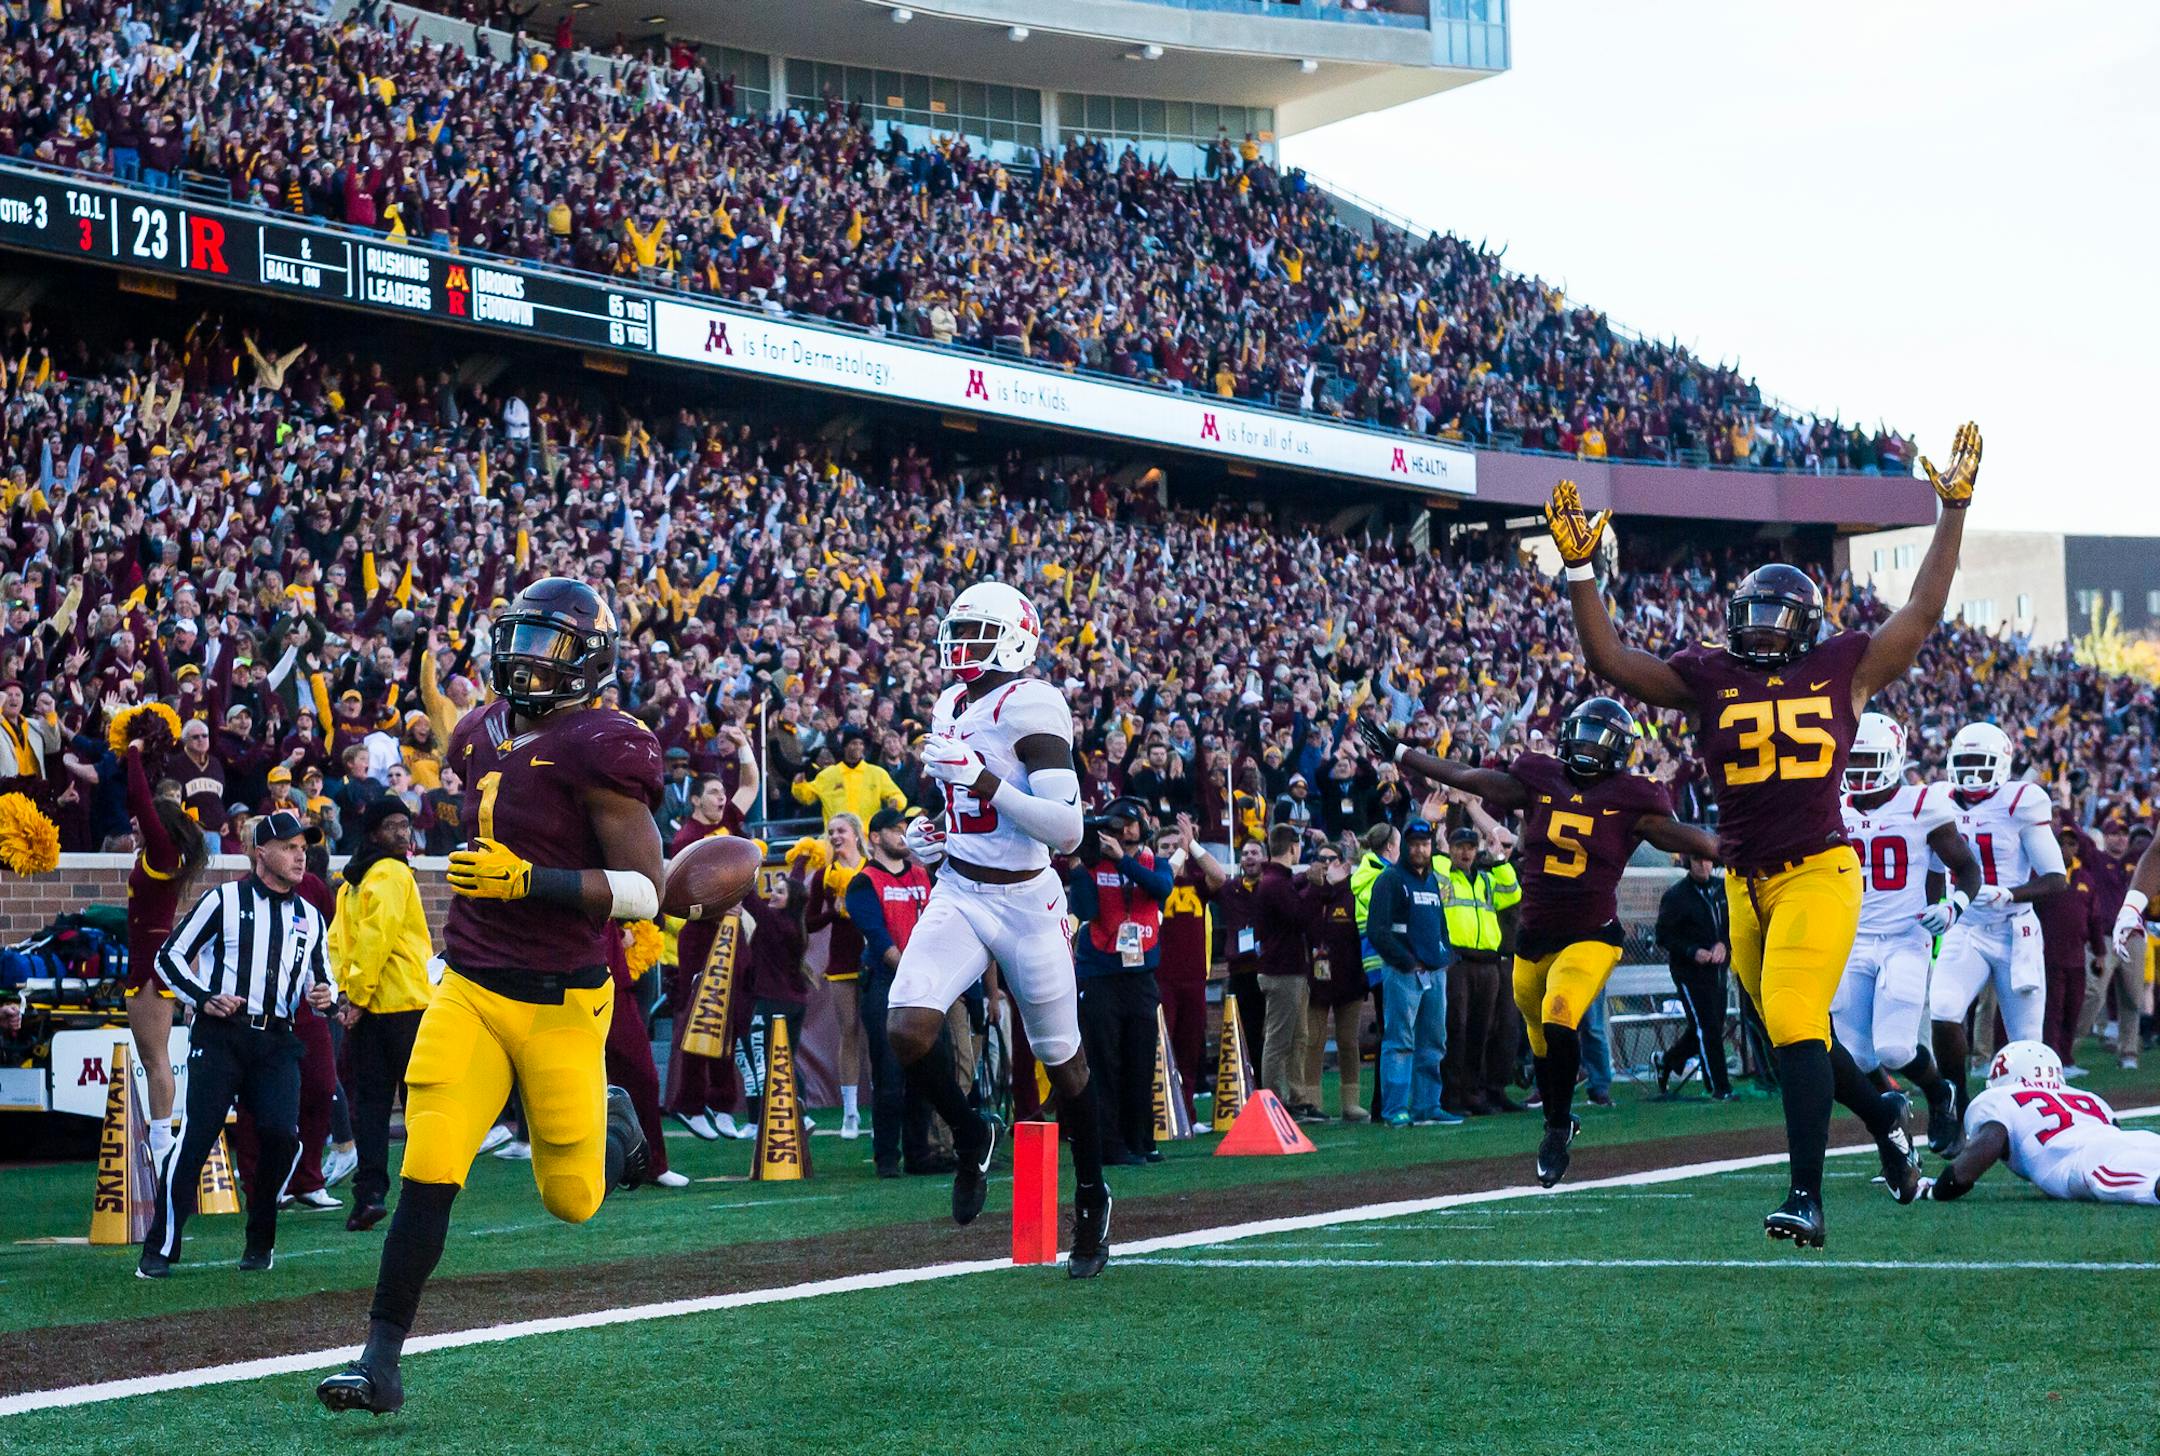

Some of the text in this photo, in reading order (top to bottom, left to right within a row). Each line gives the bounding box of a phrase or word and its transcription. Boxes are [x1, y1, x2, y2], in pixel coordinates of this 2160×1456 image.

[35, 196, 48, 229] 3
[80, 219, 92, 250] 3
[132, 206, 168, 259] 23
[190, 216, 229, 274] R
[301, 238, 311, 260] &
[266, 260, 321, 288] BALL ON
[366, 248, 430, 282] RUSHING
[367, 277, 432, 311] LEADERS
[477, 268, 525, 299] BROOKS
[448, 291, 466, 316] R
[742, 332, 755, 356] is
[762, 334, 786, 361] for
[997, 380, 1009, 401] is
[1014, 380, 1034, 405] for
[1039, 386, 1070, 413] Kids.
[1226, 423, 1238, 441] is
[1241, 422, 1259, 445] for
[1263, 427, 1277, 448] all
[1281, 430, 1293, 451] of
[1411, 456, 1448, 478] HEALTH
[1718, 695, 1837, 786] 35
[476, 771, 504, 841] 1
[1543, 810, 1595, 879] 5
[688, 924, 734, 1039] SKI-U-MAH
[77, 1057, 109, 1086] M
[1217, 1021, 1239, 1121] SKI-U-MAH
[766, 1045, 798, 1164] SKI-U-MAH
[2010, 1090, 2111, 1146] 39
[94, 1067, 125, 1213] SKI-U-MAH
